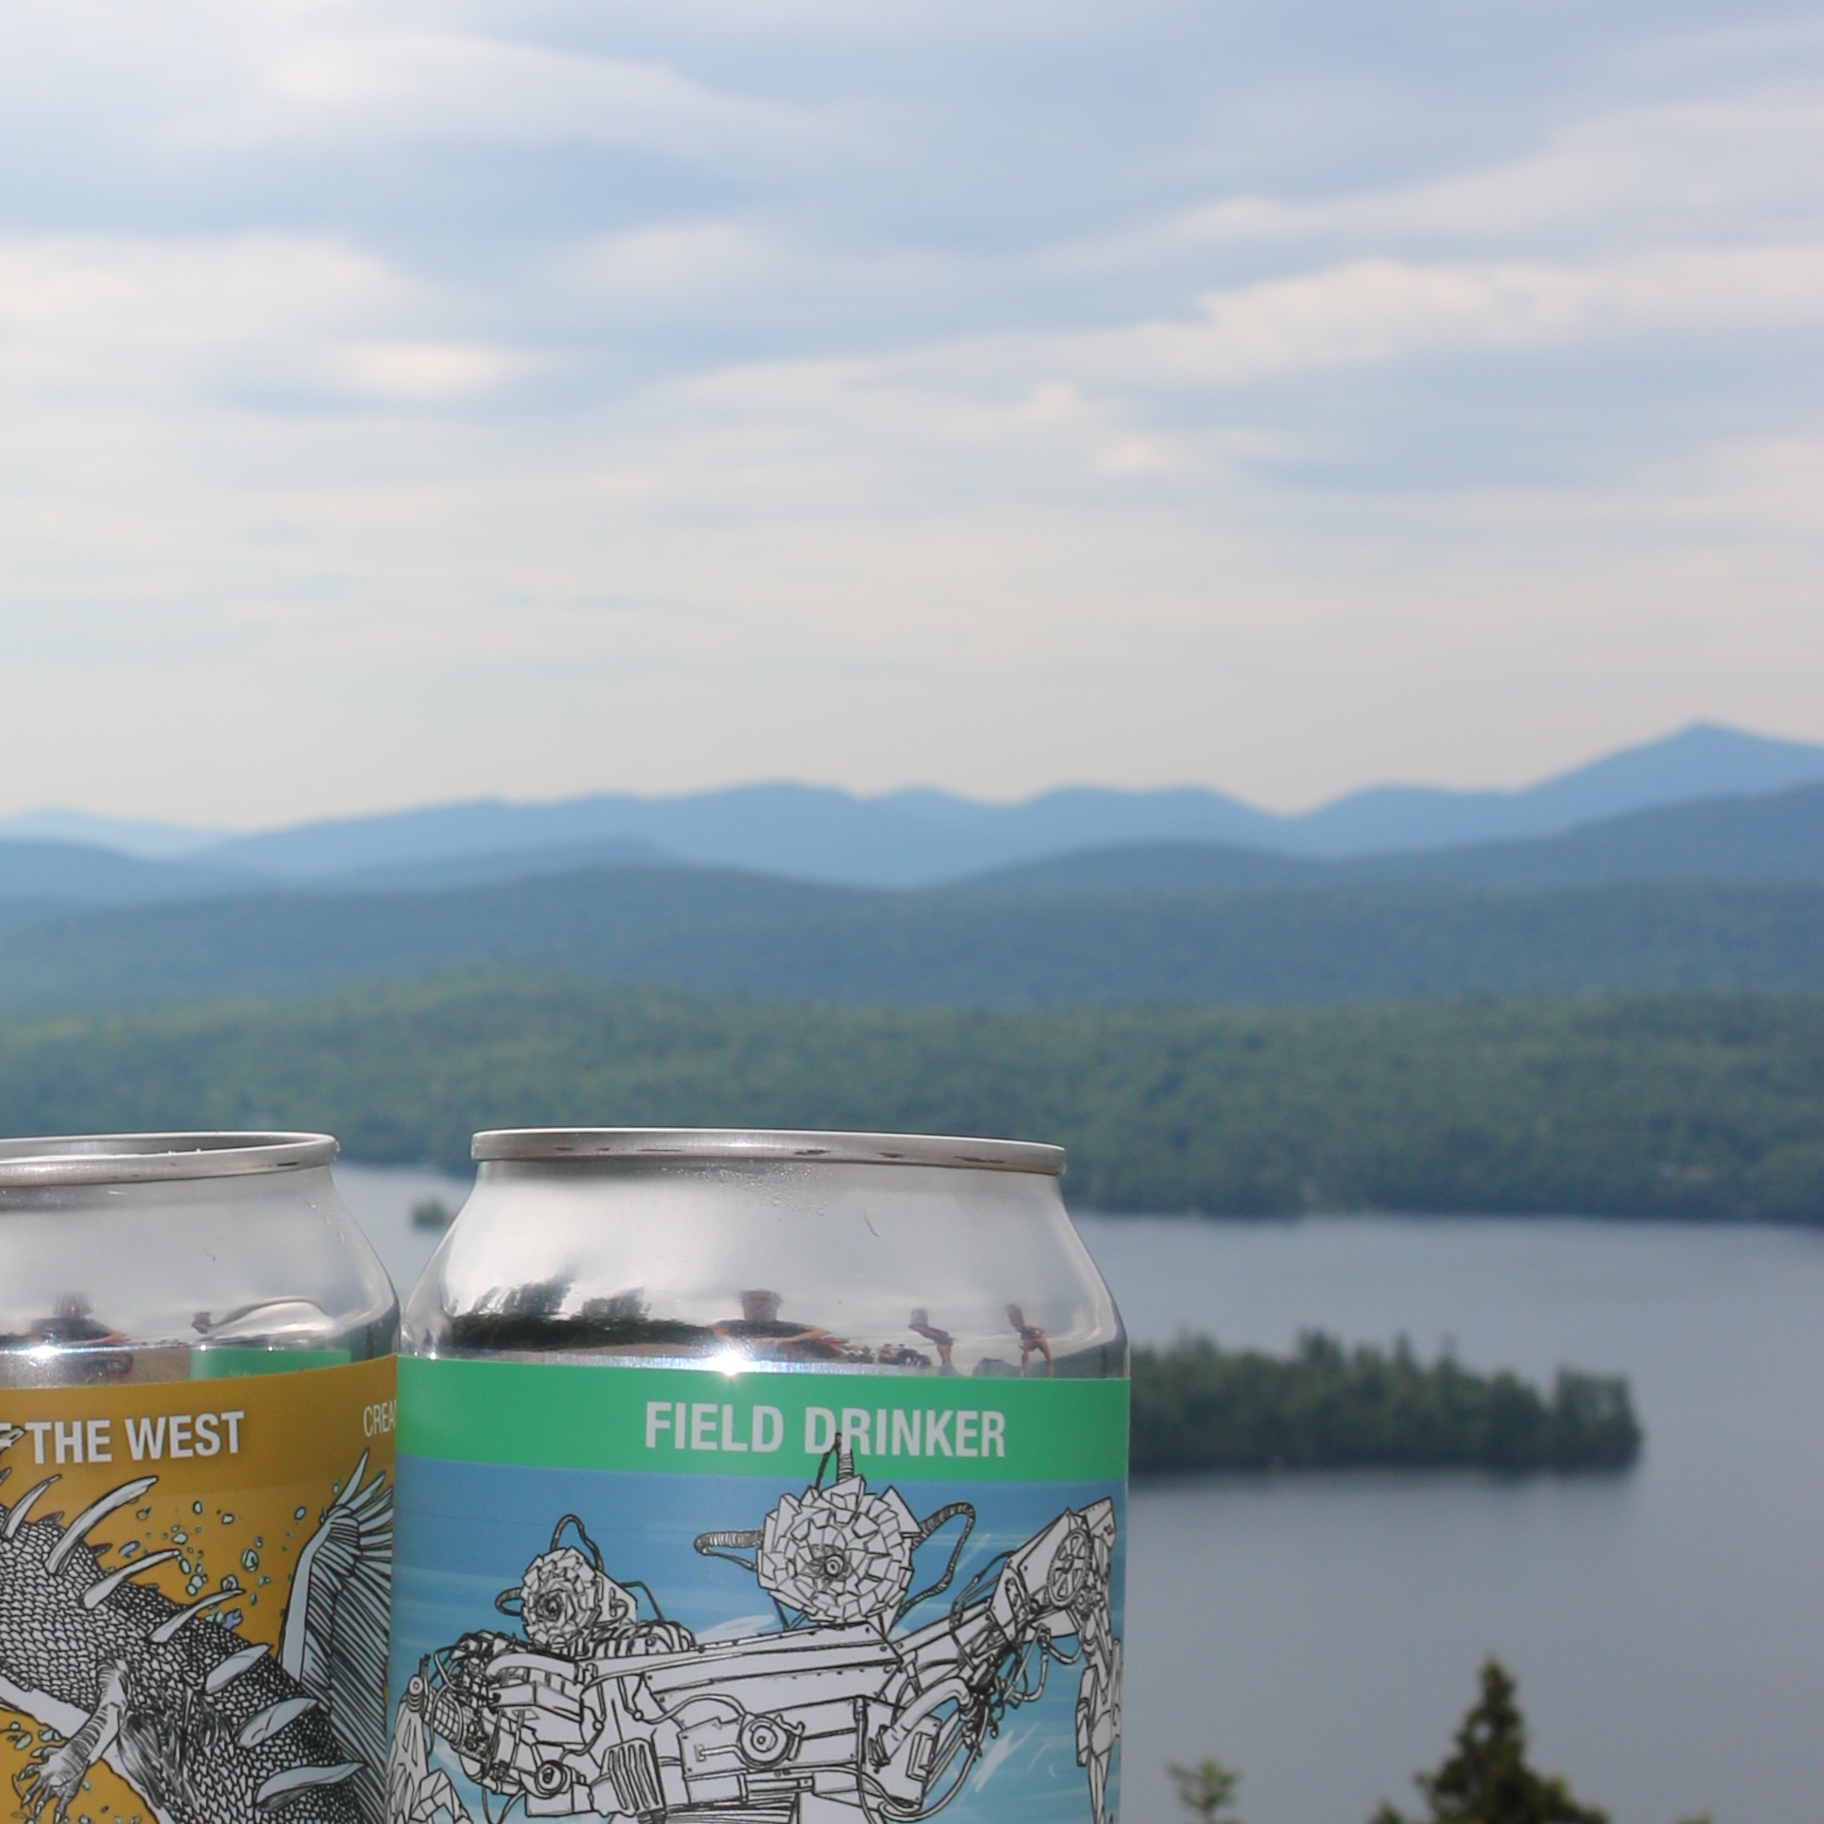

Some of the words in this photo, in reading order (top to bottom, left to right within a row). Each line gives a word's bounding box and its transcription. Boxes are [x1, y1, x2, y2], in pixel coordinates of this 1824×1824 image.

[25, 1419, 112, 1464] THE
[124, 1410, 245, 1461] WEST
[363, 1398, 397, 1437] CREA
[645, 1401, 784, 1453] FIELD
[804, 1406, 1006, 1458] DRINKER
